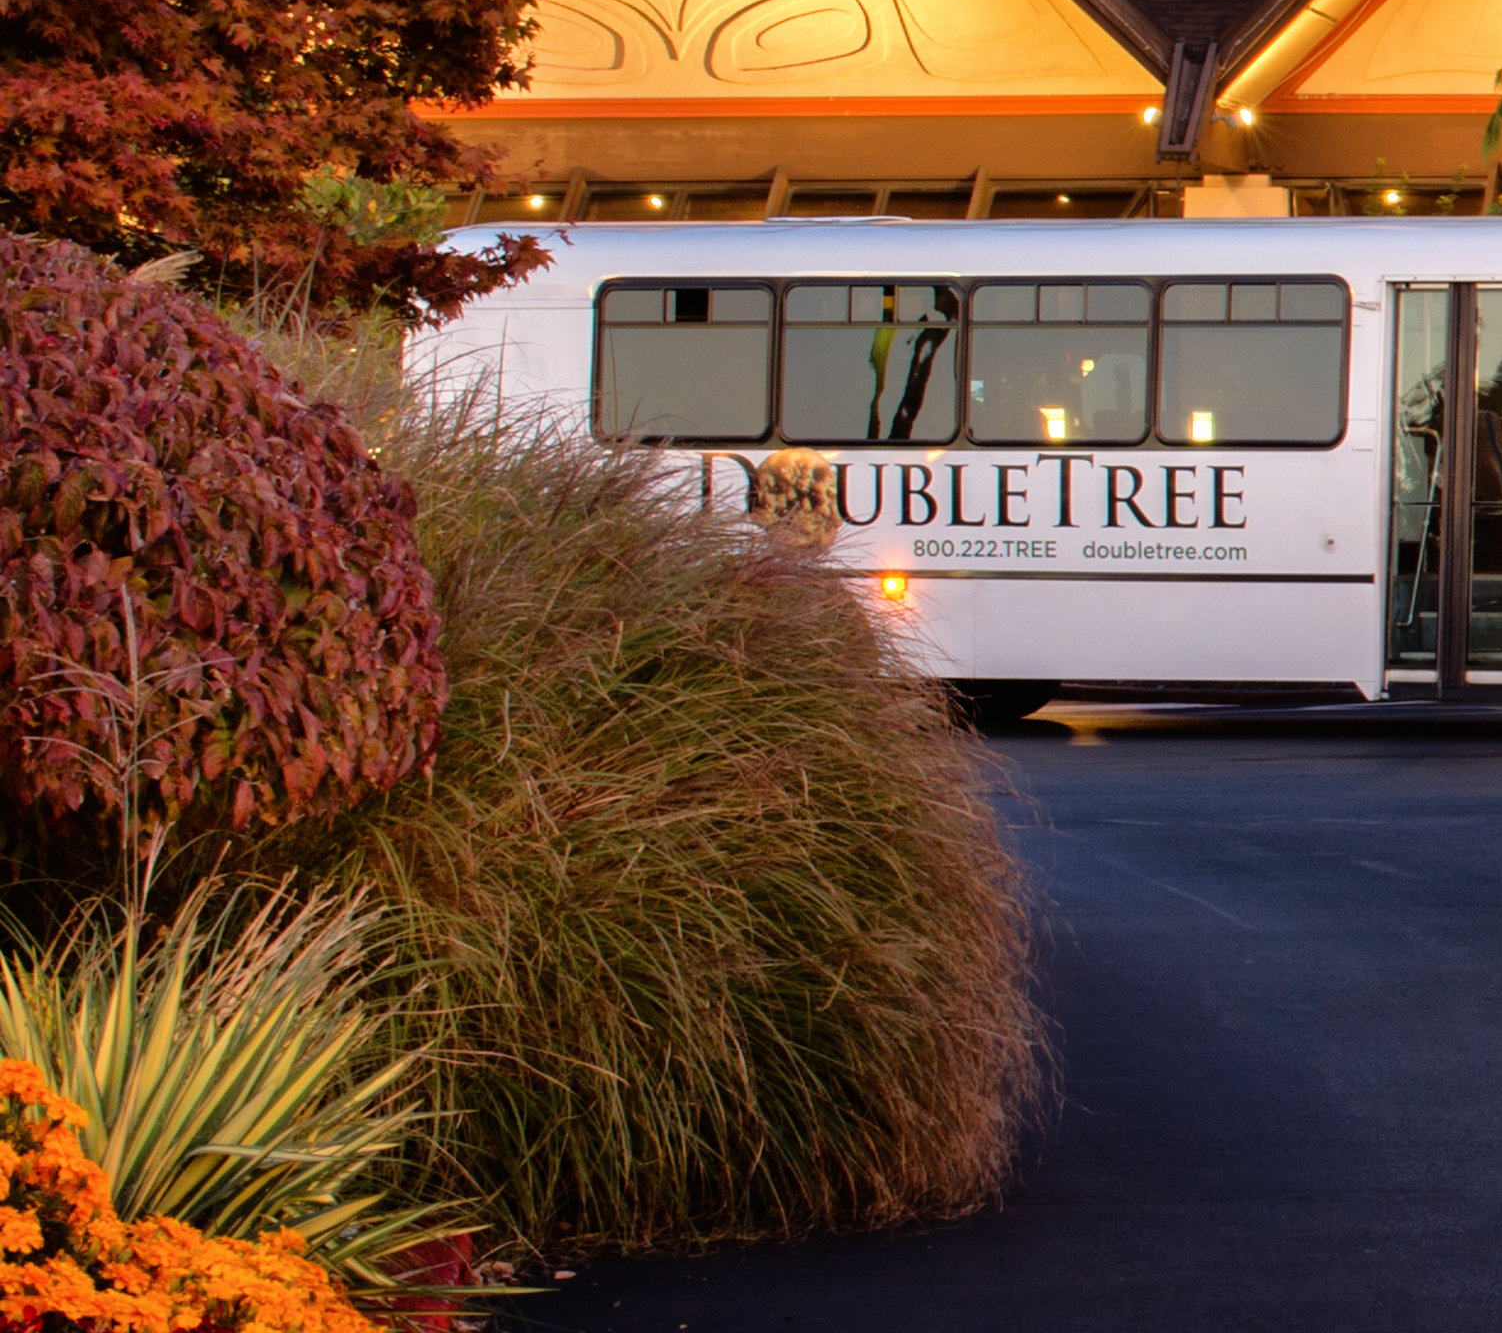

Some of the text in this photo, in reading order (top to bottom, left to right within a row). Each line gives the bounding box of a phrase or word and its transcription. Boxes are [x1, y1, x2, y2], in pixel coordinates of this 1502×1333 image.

[696, 450, 1248, 530] DUBLETREE
[913, 539, 1248, 562] 800.222.TREE doubletree.com
